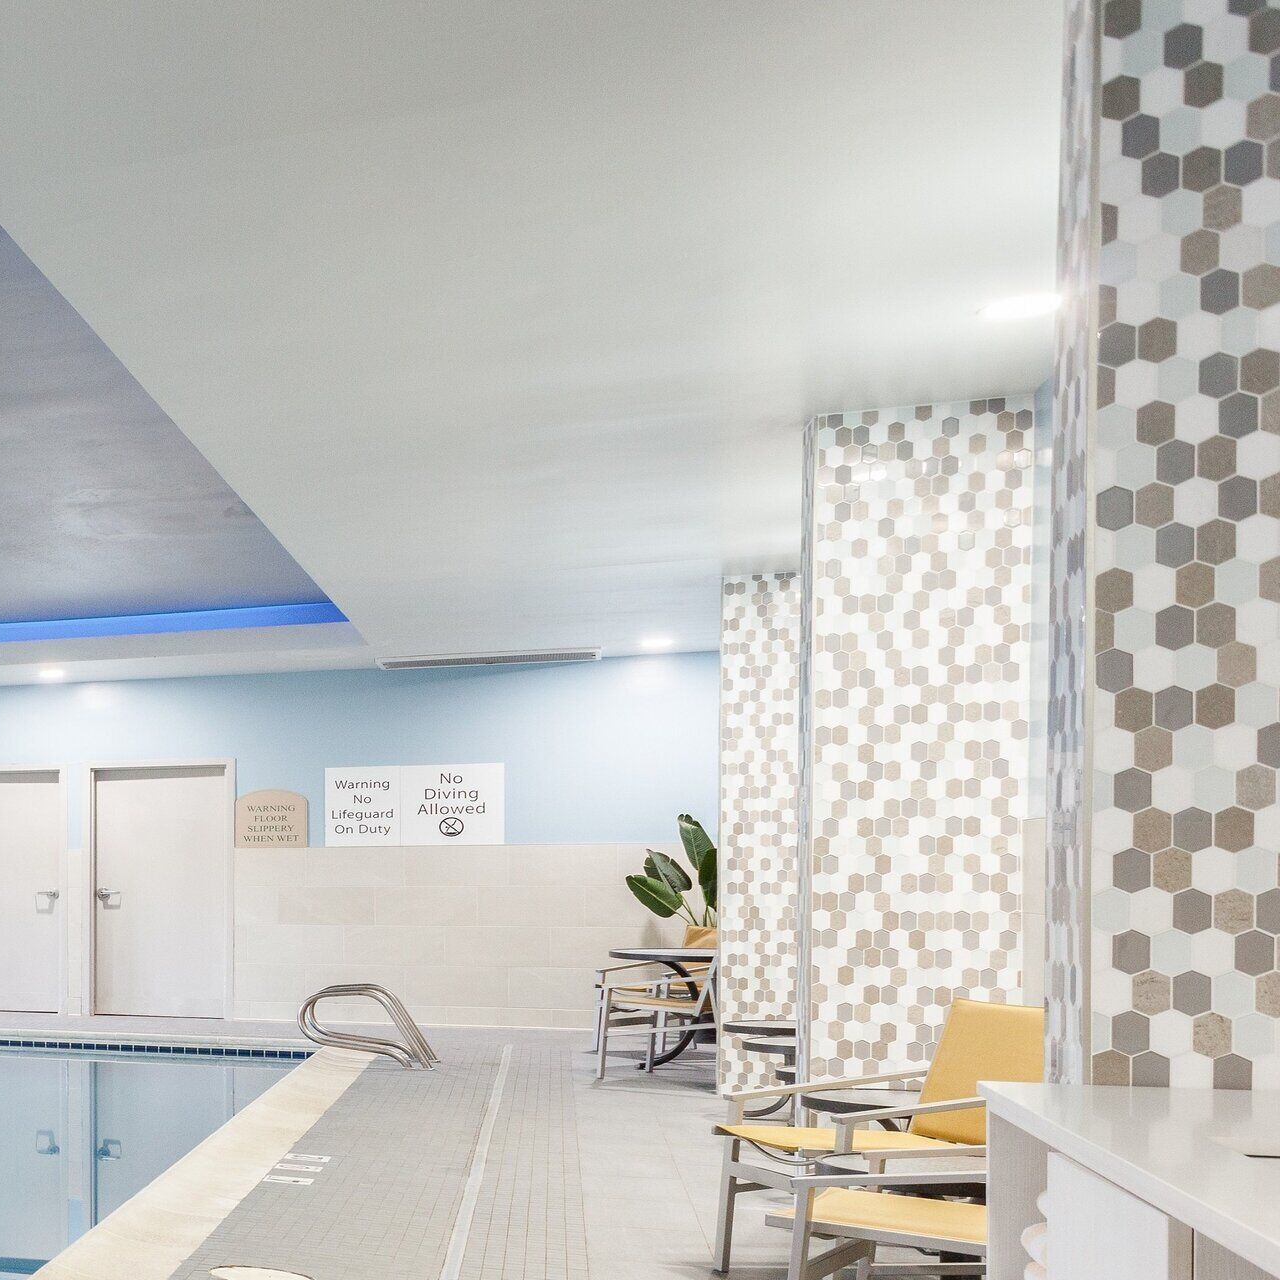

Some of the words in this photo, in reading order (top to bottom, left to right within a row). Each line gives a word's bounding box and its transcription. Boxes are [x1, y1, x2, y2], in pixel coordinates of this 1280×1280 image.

[440, 773, 463, 784] No
[335, 780, 390, 790] Warning
[353, 795, 372, 804] No
[425, 788, 479, 802] Diving
[418, 802, 485, 815] Allowed
[332, 809, 394, 821] Lifeguard
[335, 825, 353, 834] On
[359, 825, 391, 835] Duty
